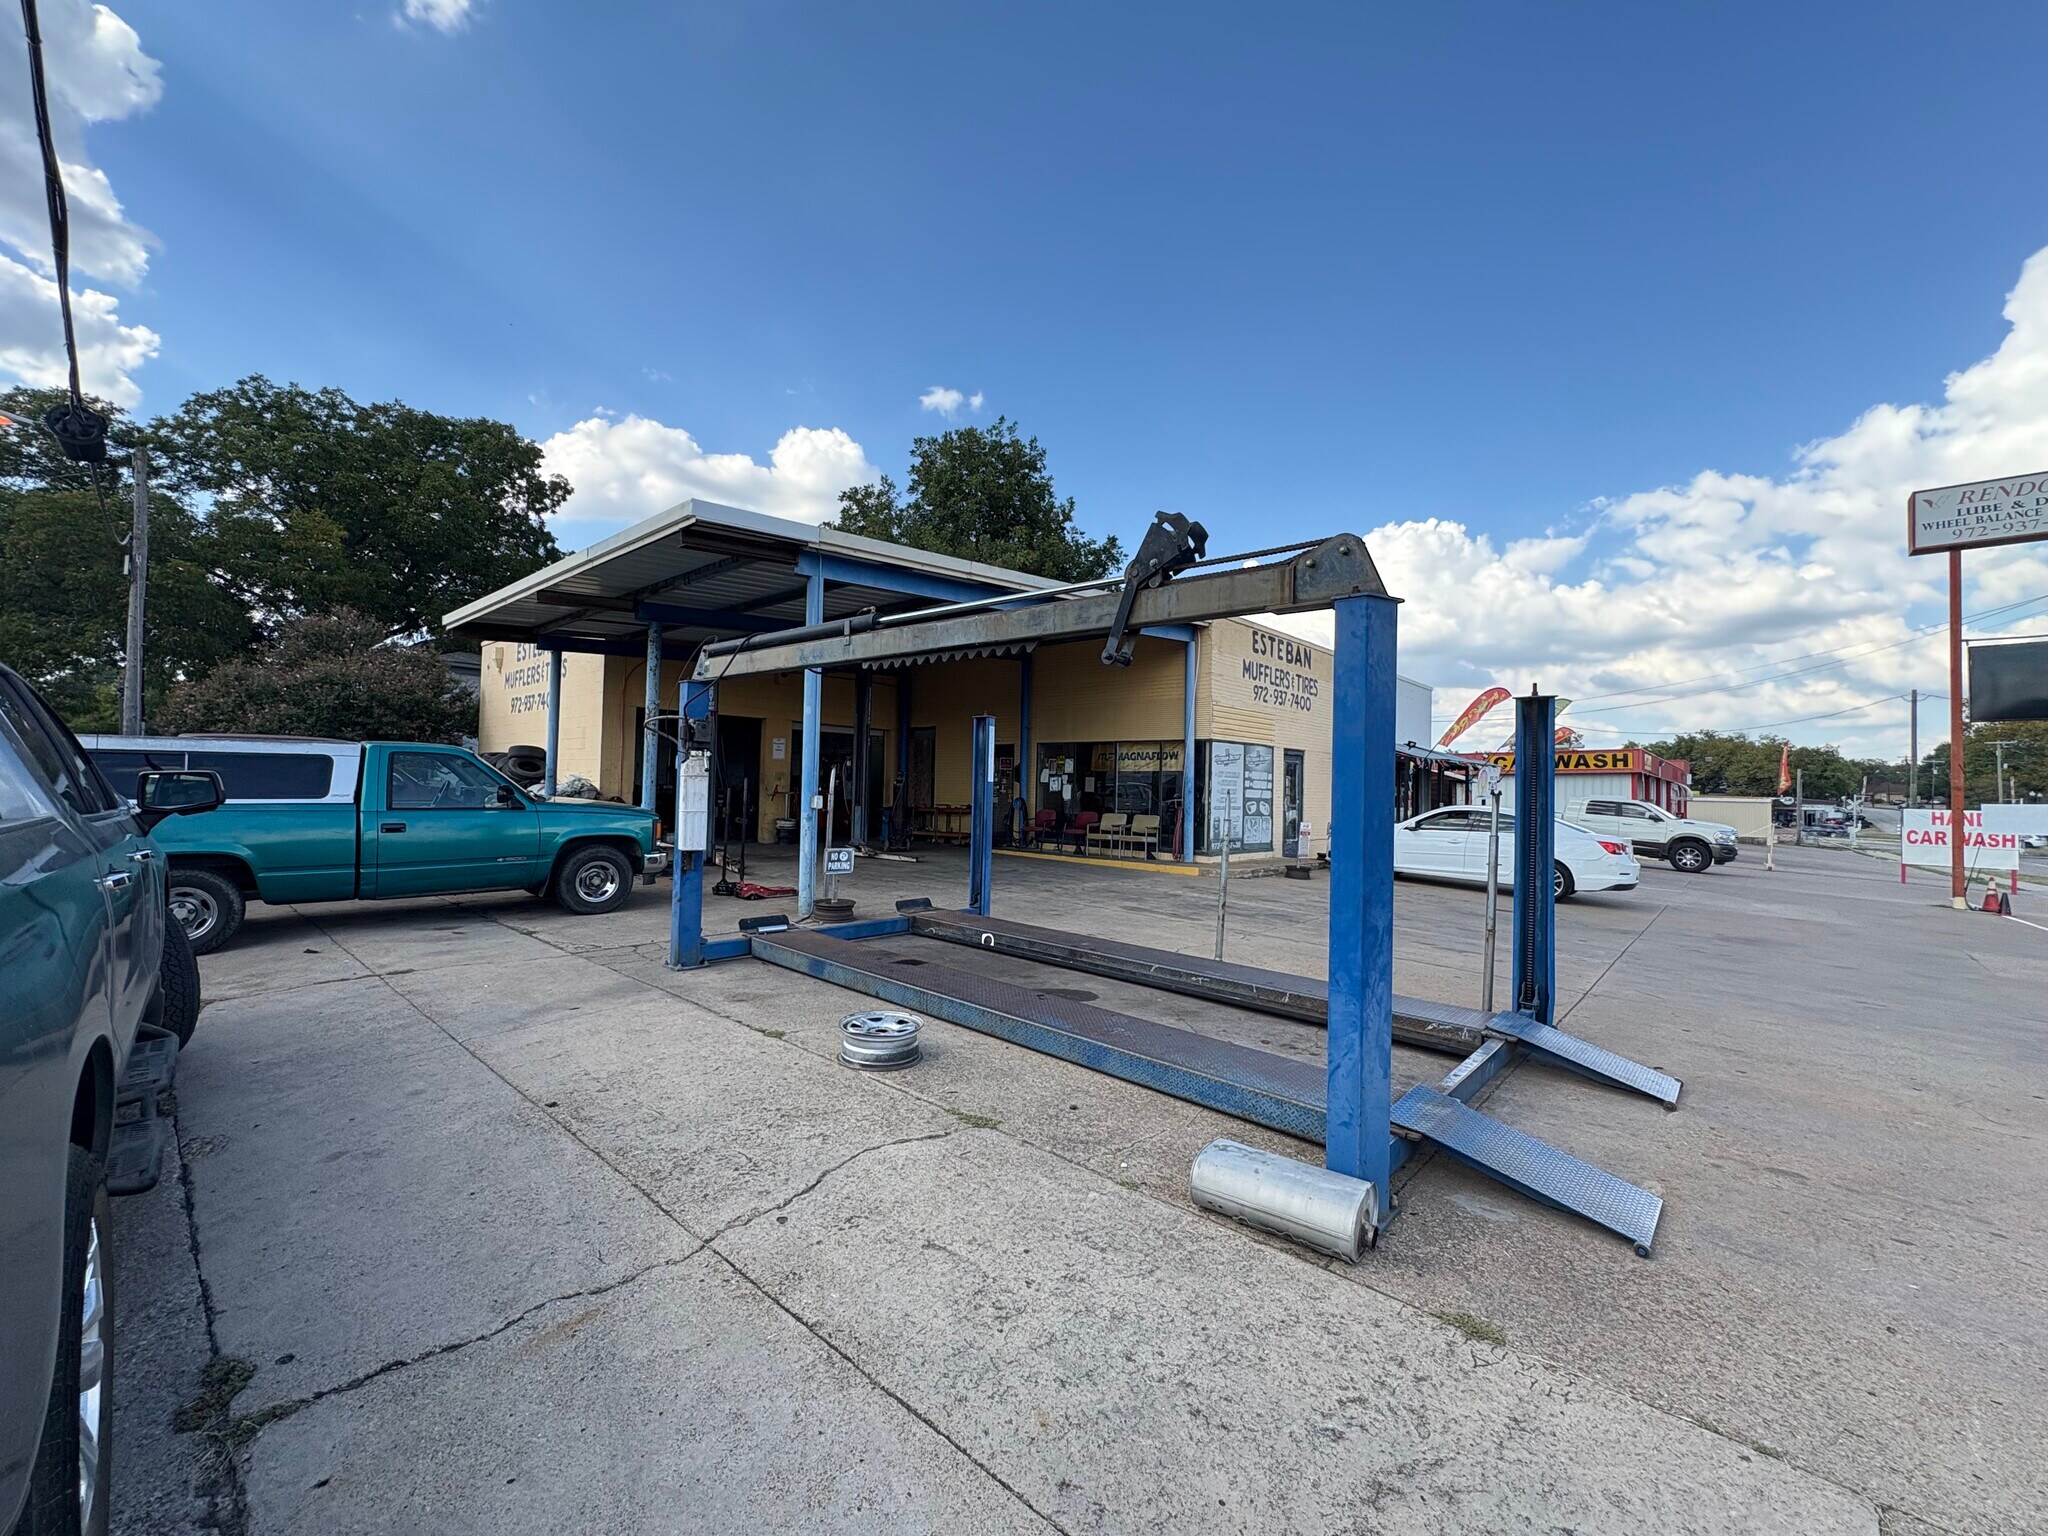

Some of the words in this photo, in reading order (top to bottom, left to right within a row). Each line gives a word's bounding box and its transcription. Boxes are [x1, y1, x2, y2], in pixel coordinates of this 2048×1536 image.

[1956, 502, 2003, 517] LUBE
[2011, 500, 2026, 510] &
[1922, 517, 1971, 531] WHEEL
[1975, 507, 2043, 525] BALANCE
[1252, 630, 1312, 670] ESTEBAN
[504, 664, 541, 690] MUFFLERS
[1242, 658, 1291, 690] MUFFLERS
[1295, 674, 1318, 697] TIRES
[1555, 753, 1629, 769] WASH
[1906, 830, 1948, 845] CAR
[831, 852, 839, 860] NO
[828, 861, 850, 870] PARKING
